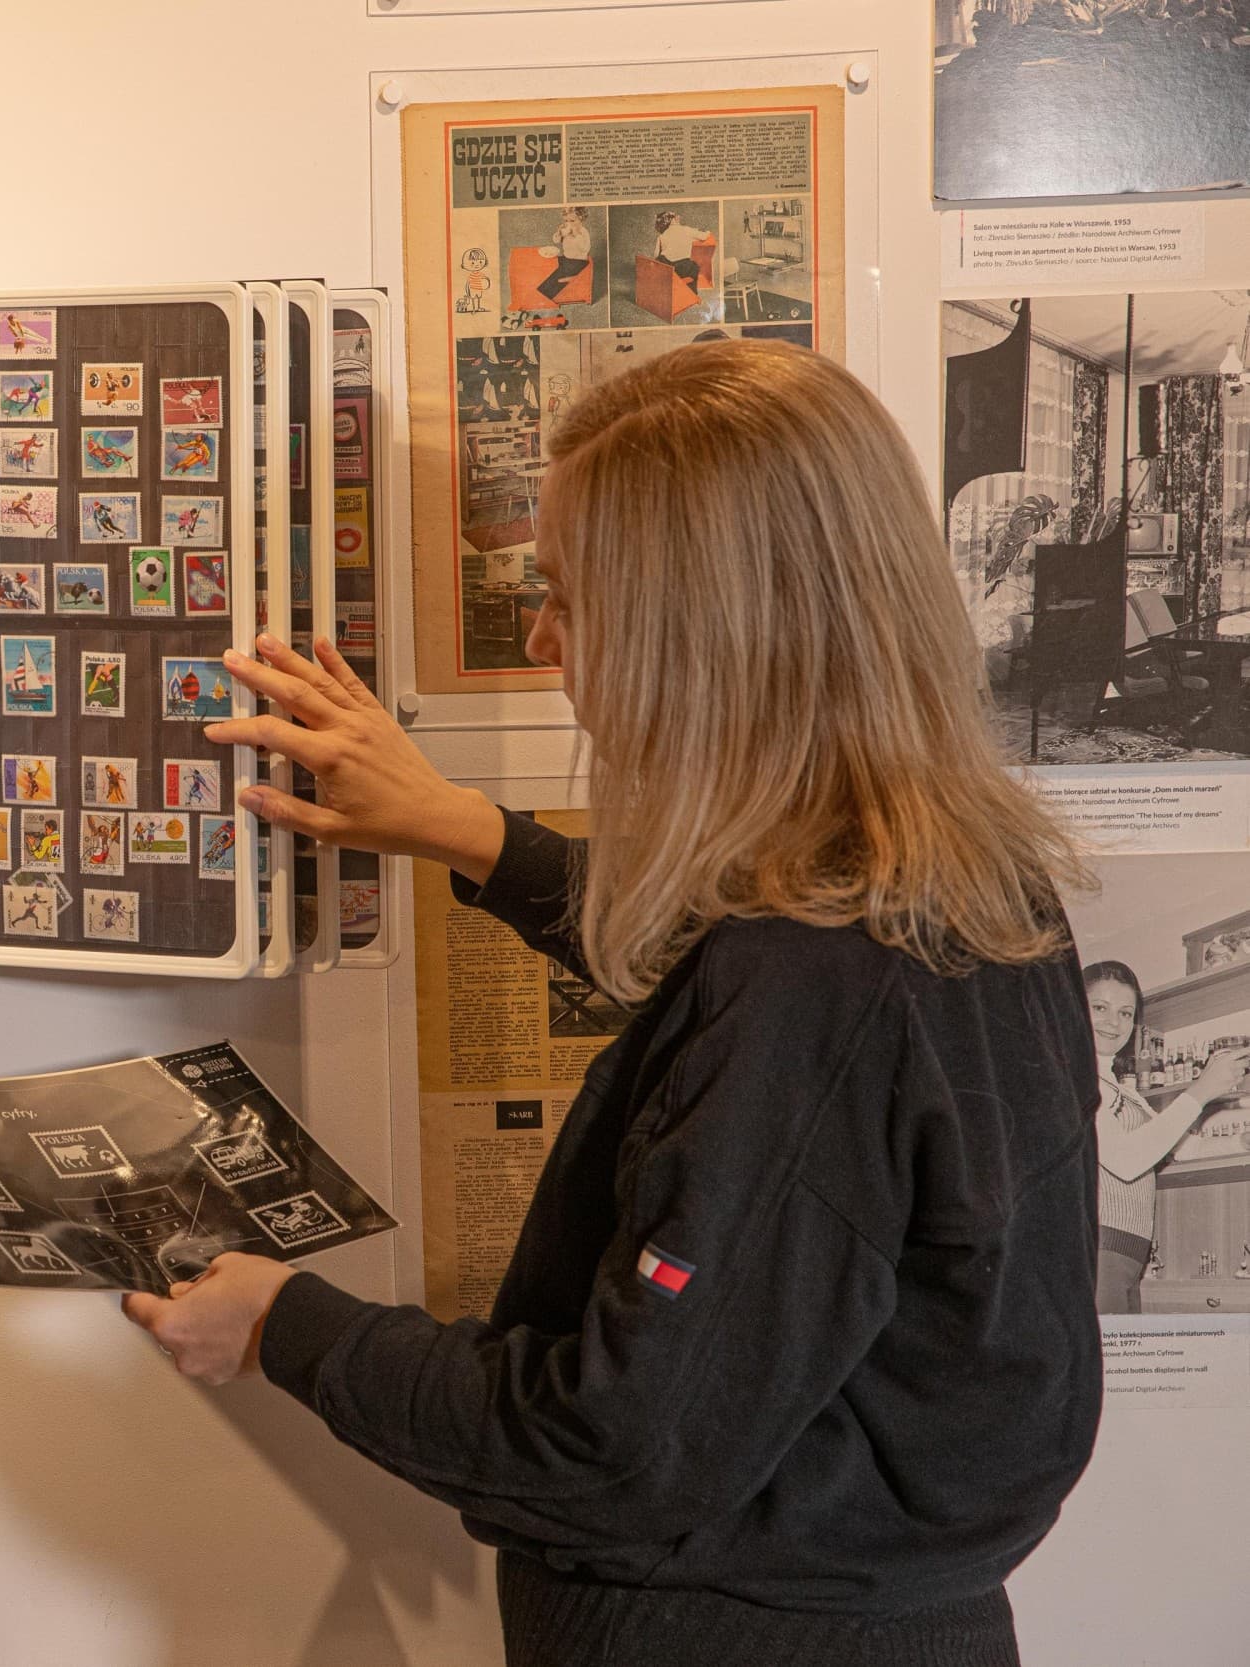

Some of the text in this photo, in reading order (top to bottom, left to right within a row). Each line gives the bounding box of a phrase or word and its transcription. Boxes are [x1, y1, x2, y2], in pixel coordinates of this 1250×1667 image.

[453, 135, 517, 166] GDZIE
[524, 133, 561, 164] SIĘ
[471, 161, 545, 200] UCZYĆ
[1130, 255, 1152, 263] Digital
[1118, 786, 1150, 794] konkursie
[1151, 797, 1180, 805] Cyfrowe
[1094, 813, 1135, 821] competition
[1, 1108, 38, 1120] cyfry.
[40, 1134, 87, 1145] POLSKA
[1103, 1330, 1225, 1340] było kolekcjonowanie miniaturowych
[1154, 1366, 1185, 1375] displayed
[1135, 1385, 1157, 1393] Digital
